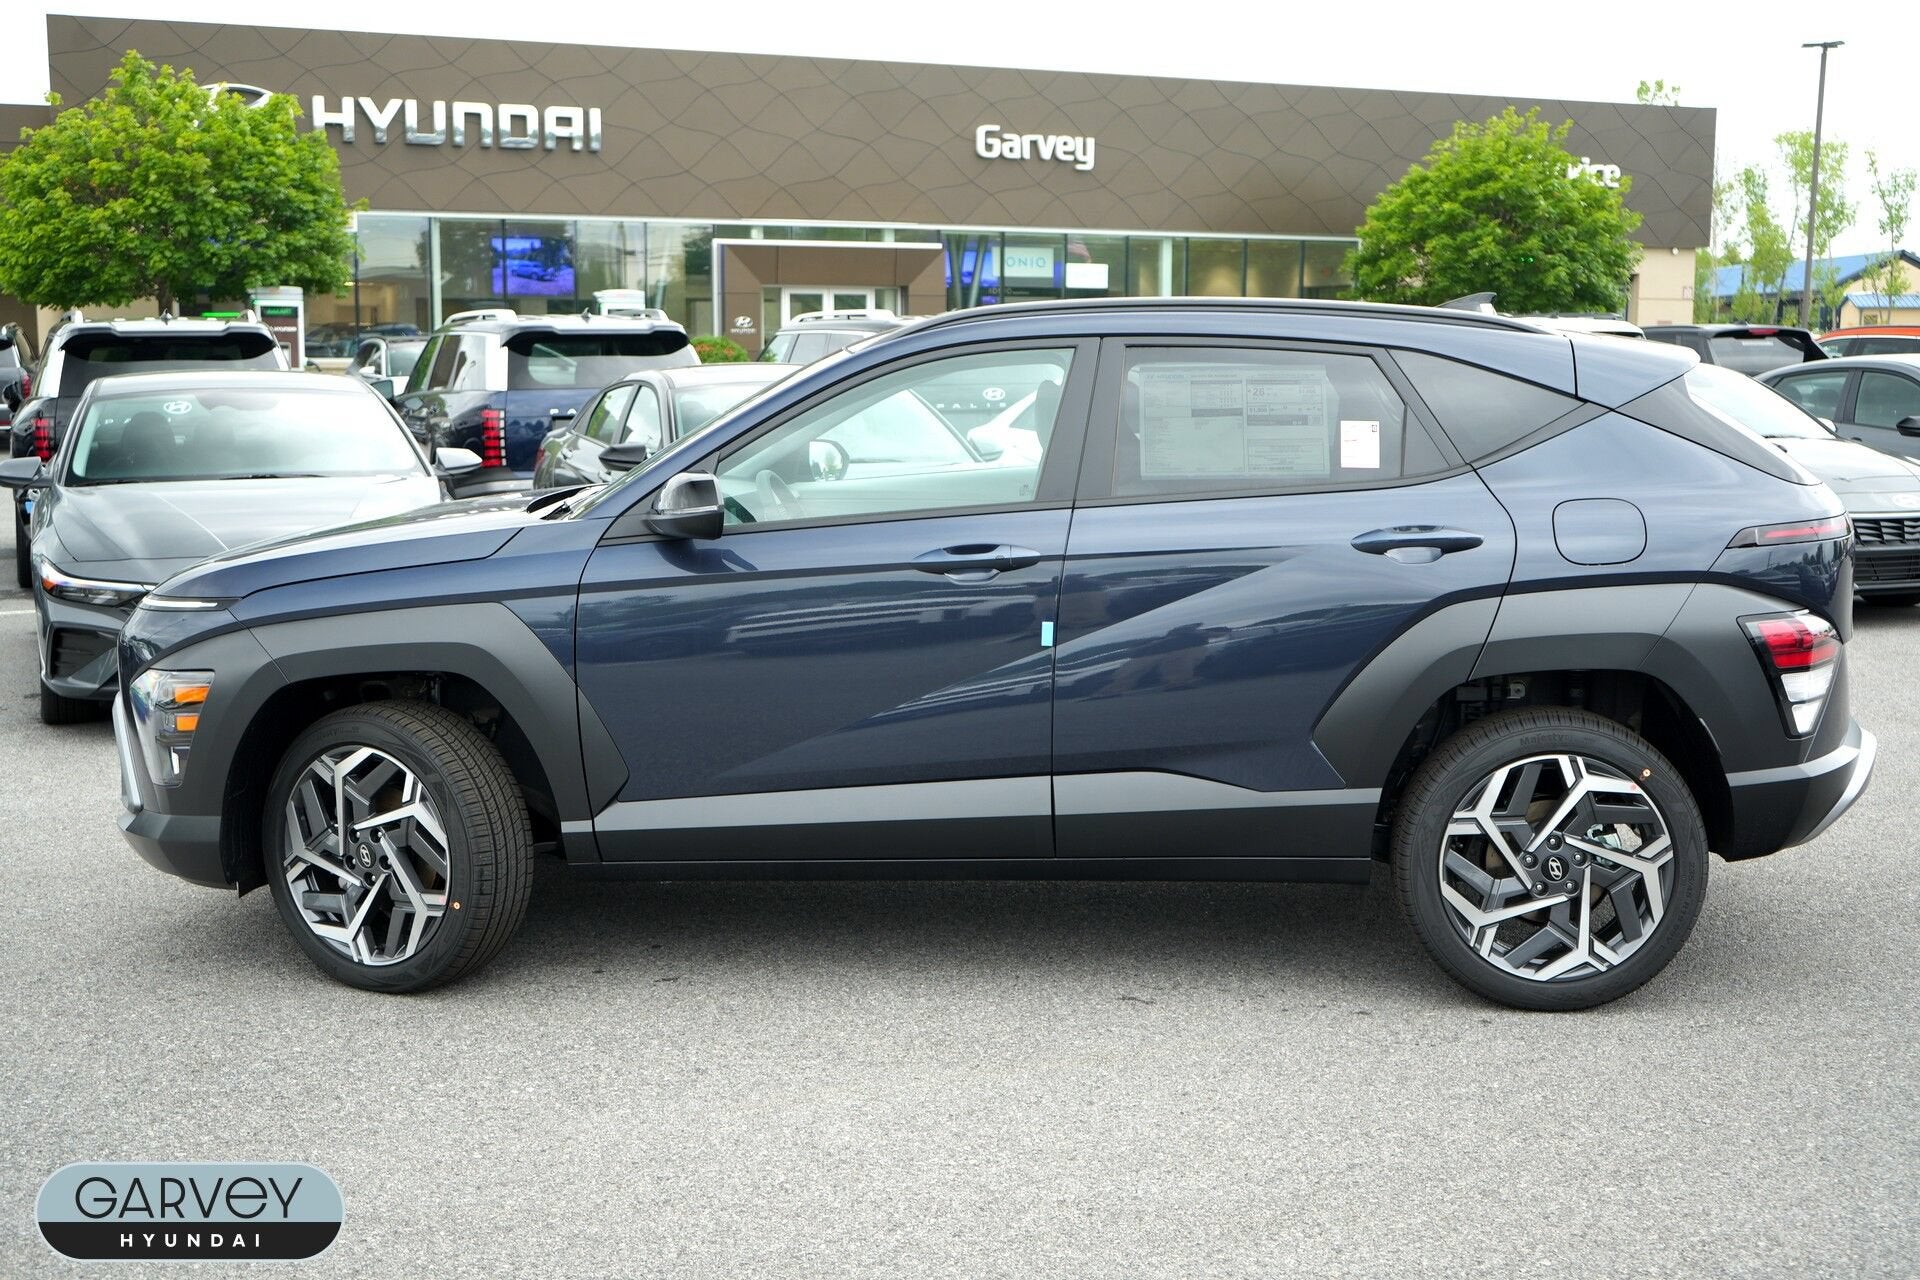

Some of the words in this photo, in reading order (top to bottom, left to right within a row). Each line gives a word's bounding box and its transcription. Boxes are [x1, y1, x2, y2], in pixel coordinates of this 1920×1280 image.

[312, 95, 602, 152] HYUNDAI
[975, 124, 1095, 171] Garvey
[1566, 157, 1621, 188] vice
[1006, 256, 1047, 268] ONIQ
